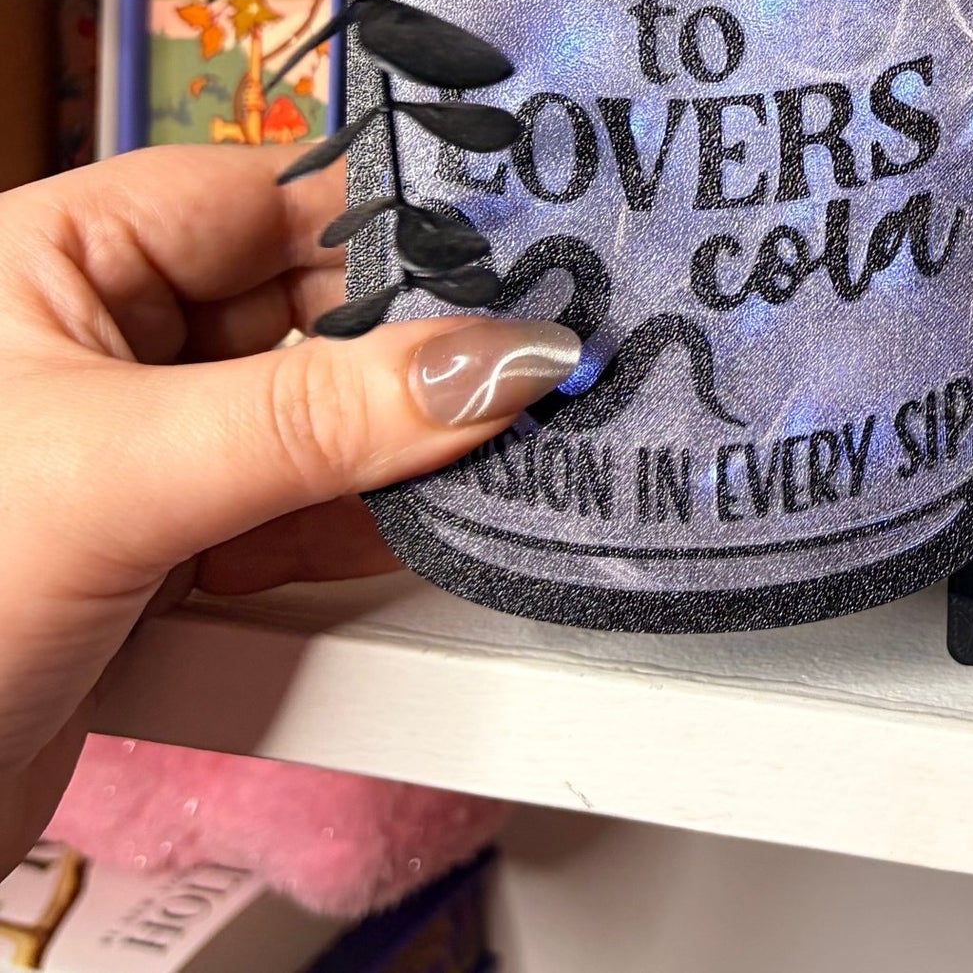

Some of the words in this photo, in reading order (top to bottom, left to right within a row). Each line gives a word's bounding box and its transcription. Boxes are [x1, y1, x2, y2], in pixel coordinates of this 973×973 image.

[435, 55, 942, 212] LOVERS
[690, 191, 964, 312] cola
[440, 423, 614, 521] SION
[637, 445, 691, 525] IN
[715, 413, 876, 523] EVERY
